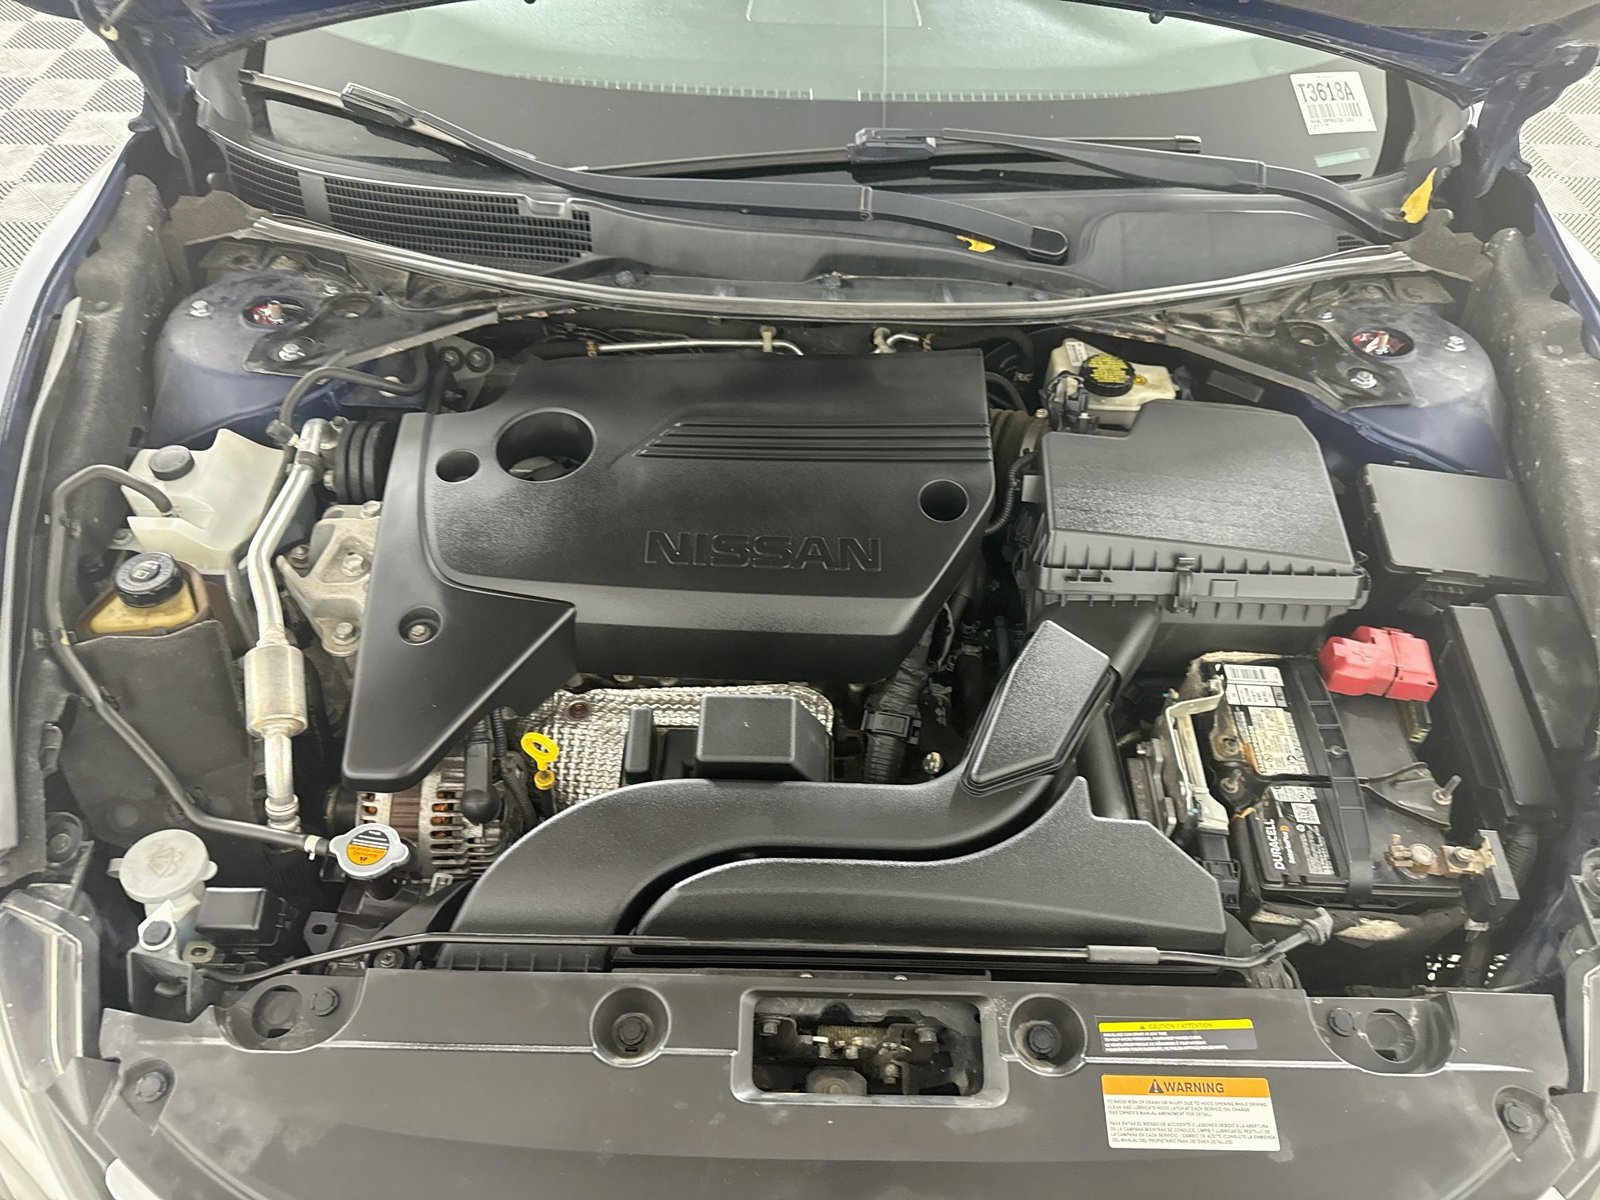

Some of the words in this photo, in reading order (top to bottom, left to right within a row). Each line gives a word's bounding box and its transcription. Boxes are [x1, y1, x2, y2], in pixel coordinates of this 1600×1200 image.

[1297, 81, 1356, 103] T3618A
[643, 530, 882, 572] NISSAN
[1263, 818, 1286, 870] DURACELL
[1163, 1081, 1225, 1093] WARNING
